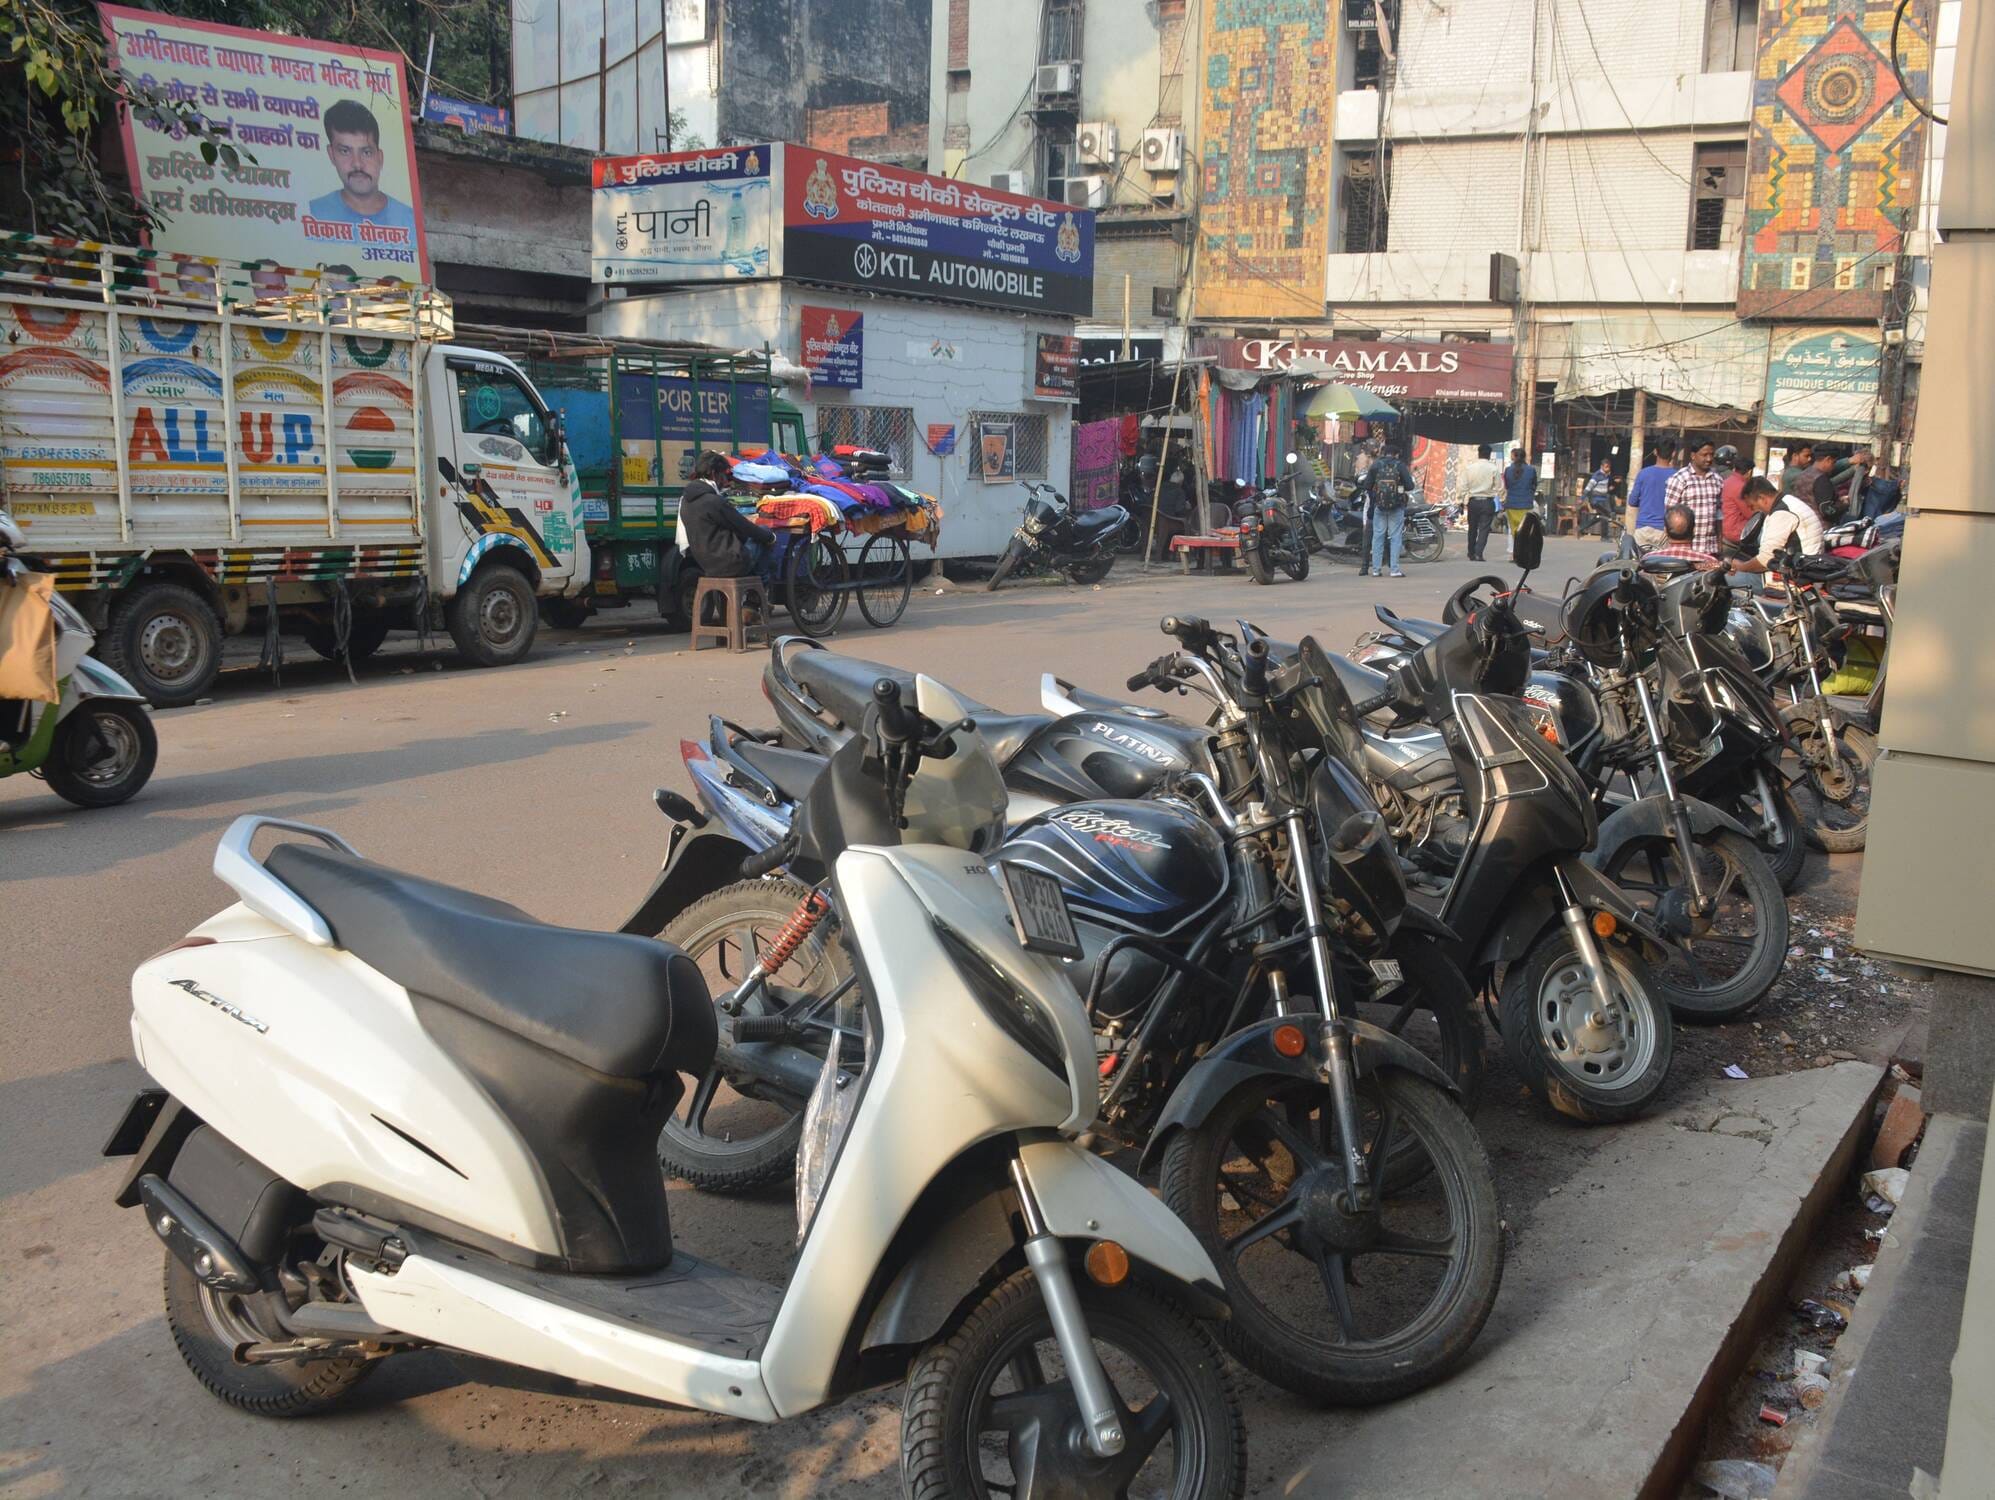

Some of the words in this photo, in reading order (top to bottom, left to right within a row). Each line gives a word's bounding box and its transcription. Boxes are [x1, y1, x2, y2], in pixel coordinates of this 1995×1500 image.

[124, 28, 210, 68] अमीनाबाद
[214, 46, 265, 75] व्यापार
[269, 55, 317, 83] मण्डल
[319, 59, 361, 90] मन्दिर
[364, 67, 393, 95] मार्ग
[199, 81, 219, 106] से
[222, 87, 260, 112] सभी
[262, 96, 320, 120] व्यापारी
[236, 123, 293, 147] ग्राहकों
[296, 131, 320, 150] का
[470, 116, 506, 135] Medical
[147, 151, 215, 184] हार्दिक
[621, 158, 681, 184] पुलिस
[190, 188, 297, 224] अभिनन्दन
[841, 166, 907, 197] पुलिस
[909, 179, 961, 208] चौकी
[963, 190, 1022, 223] सेन्ट्रल
[301, 215, 353, 241] विकास
[357, 218, 410, 244] सोनकर
[616, 211, 628, 236] KTL
[632, 199, 711, 240] पानी
[856, 197, 906, 218] कोतवाली
[1010, 227, 1046, 244] लखनऊ
[362, 246, 415, 263] अध्यक्ष
[880, 251, 920, 280] KTL
[928, 259, 1044, 298] AUTOMOBILE
[475, 363, 494, 373] MEGA
[1357, 371, 1375, 380] Shop
[1775, 377, 1825, 390] SIDDIQUE
[658, 388, 729, 415] PORTER
[128, 406, 225, 463] ALL
[240, 411, 320, 465] U.P.
[1091, 722, 1177, 767] PLATINA
[167, 978, 270, 1035] ACTIVA
